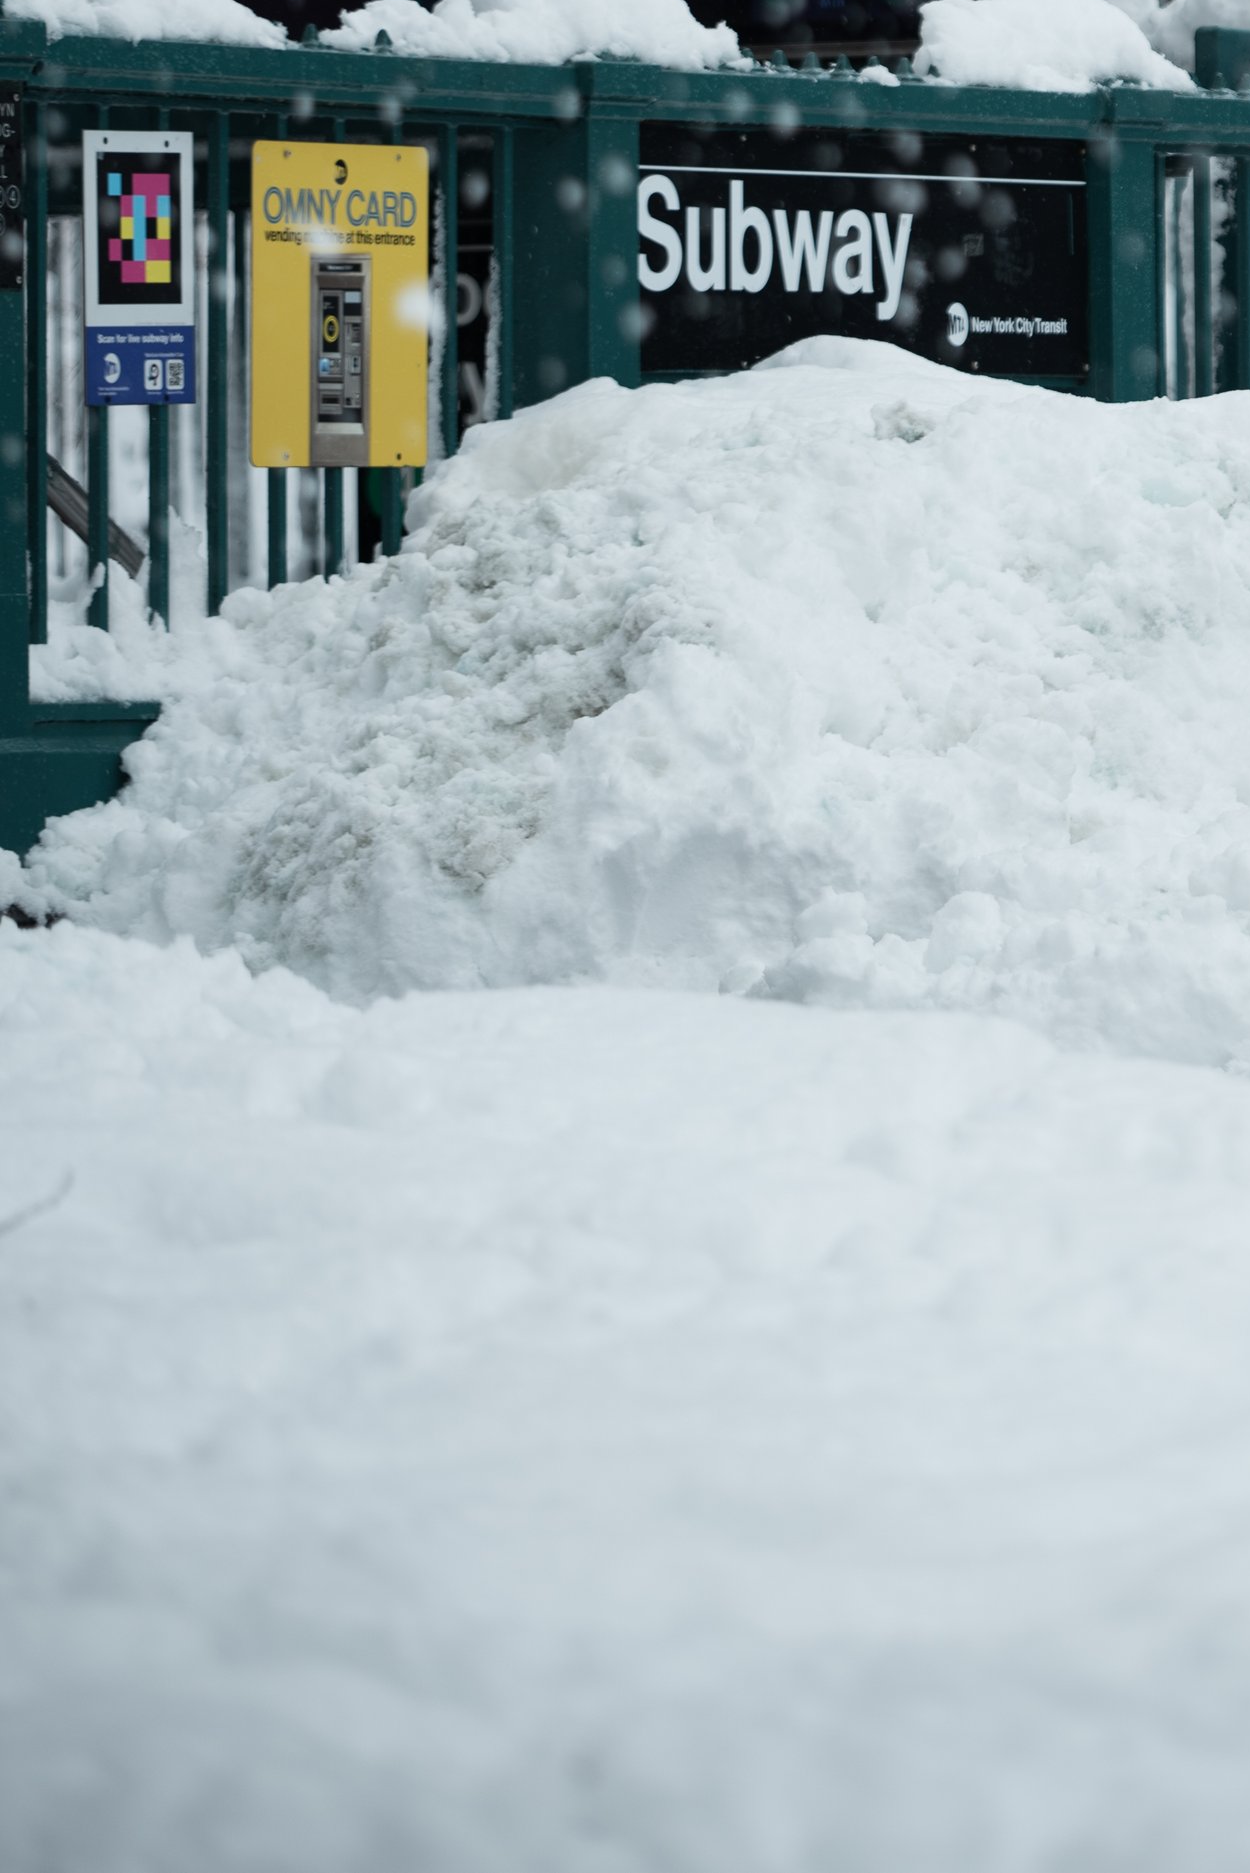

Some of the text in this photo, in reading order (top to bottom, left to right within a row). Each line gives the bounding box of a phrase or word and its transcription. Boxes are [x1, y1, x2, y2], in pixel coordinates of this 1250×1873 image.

[263, 187, 417, 228] OMNY CARD
[265, 229, 302, 245] vending
[346, 231, 355, 243] at
[356, 231, 373, 244] this
[374, 233, 415, 246] entrance
[637, 174, 913, 320] Subway
[971, 317, 992, 333] New
[993, 317, 1014, 333] York
[1015, 317, 1033, 338] City
[1033, 318, 1067, 333] Transit
[97, 333, 115, 344] Scan
